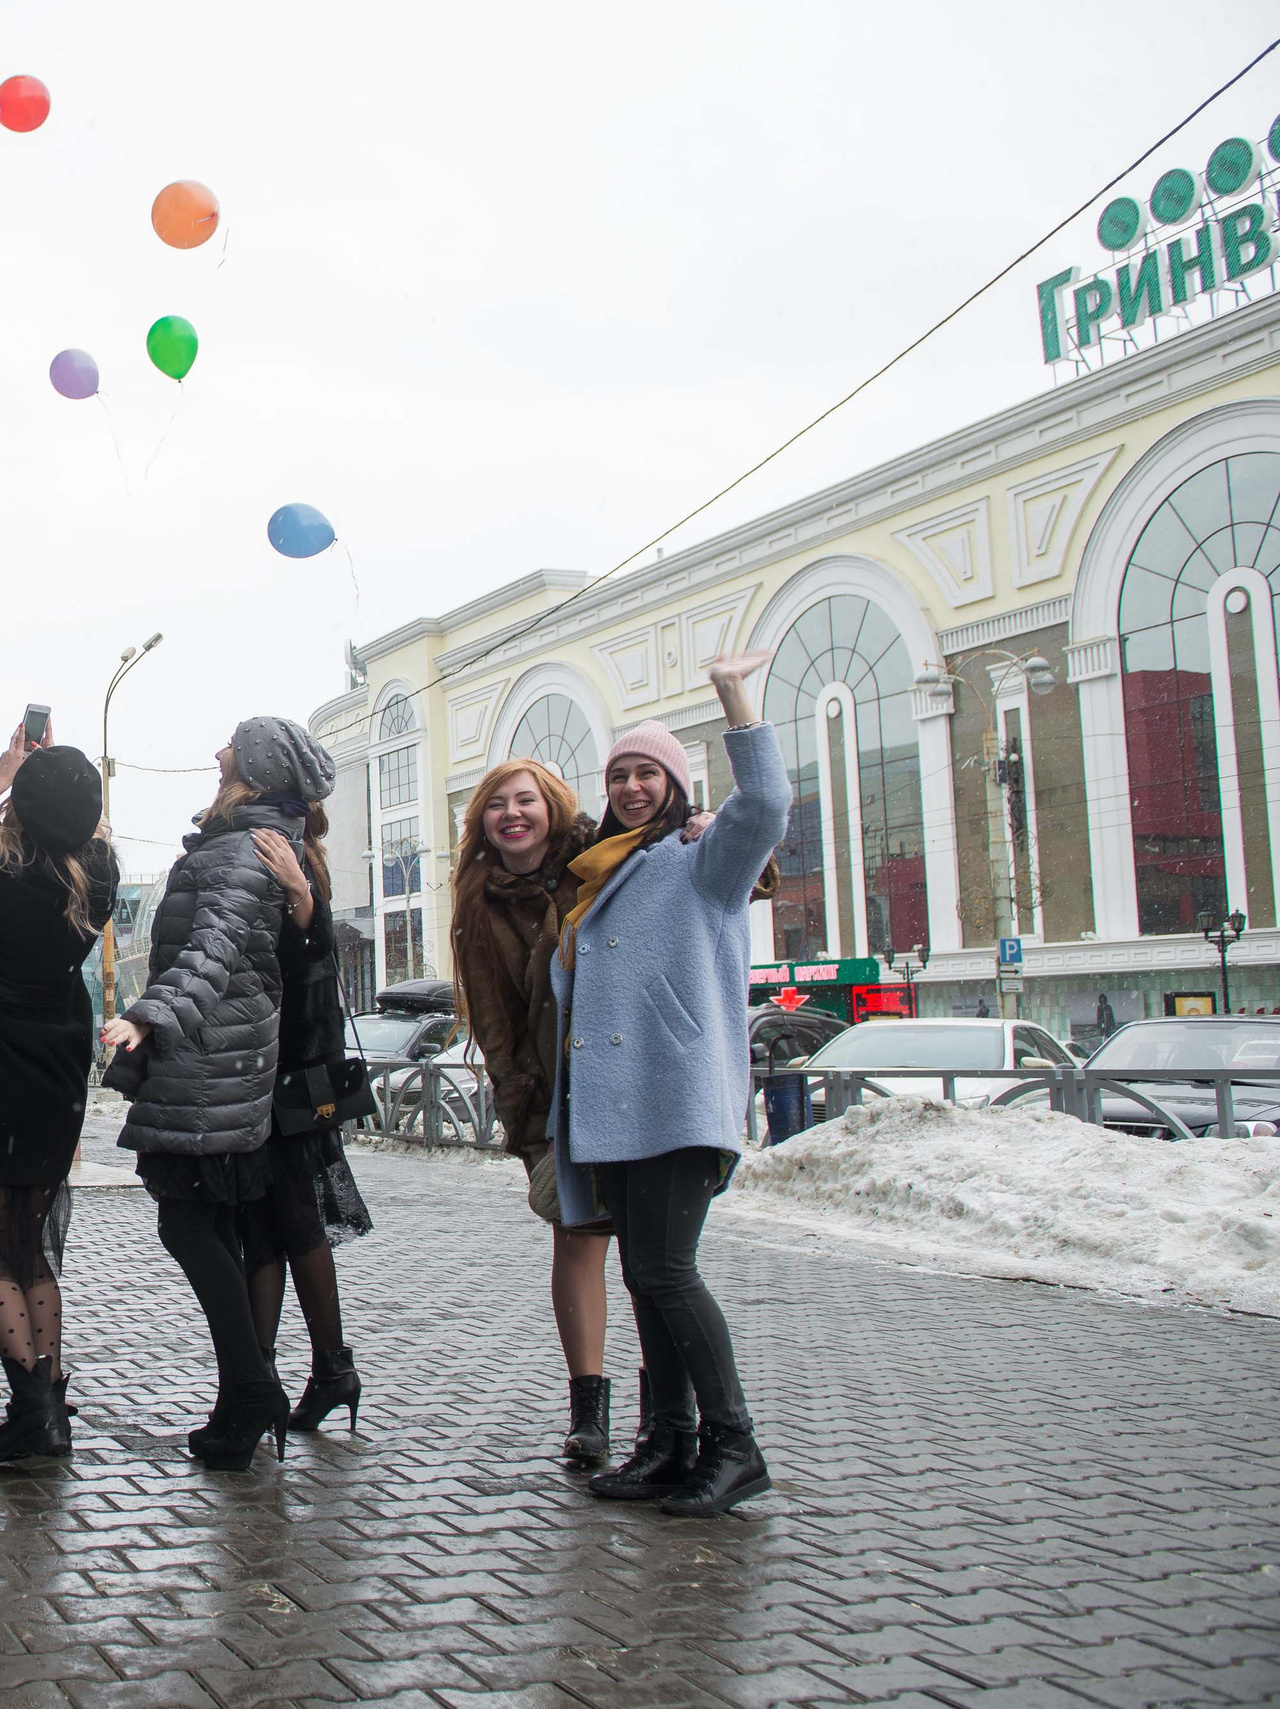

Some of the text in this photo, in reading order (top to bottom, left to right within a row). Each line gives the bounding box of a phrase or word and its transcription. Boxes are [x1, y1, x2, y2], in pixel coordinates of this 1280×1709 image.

[1036, 188, 1280, 365] ГРИНВ
[1005, 941, 1018, 962] P
[794, 964, 839, 982] ПАРКИНГ
